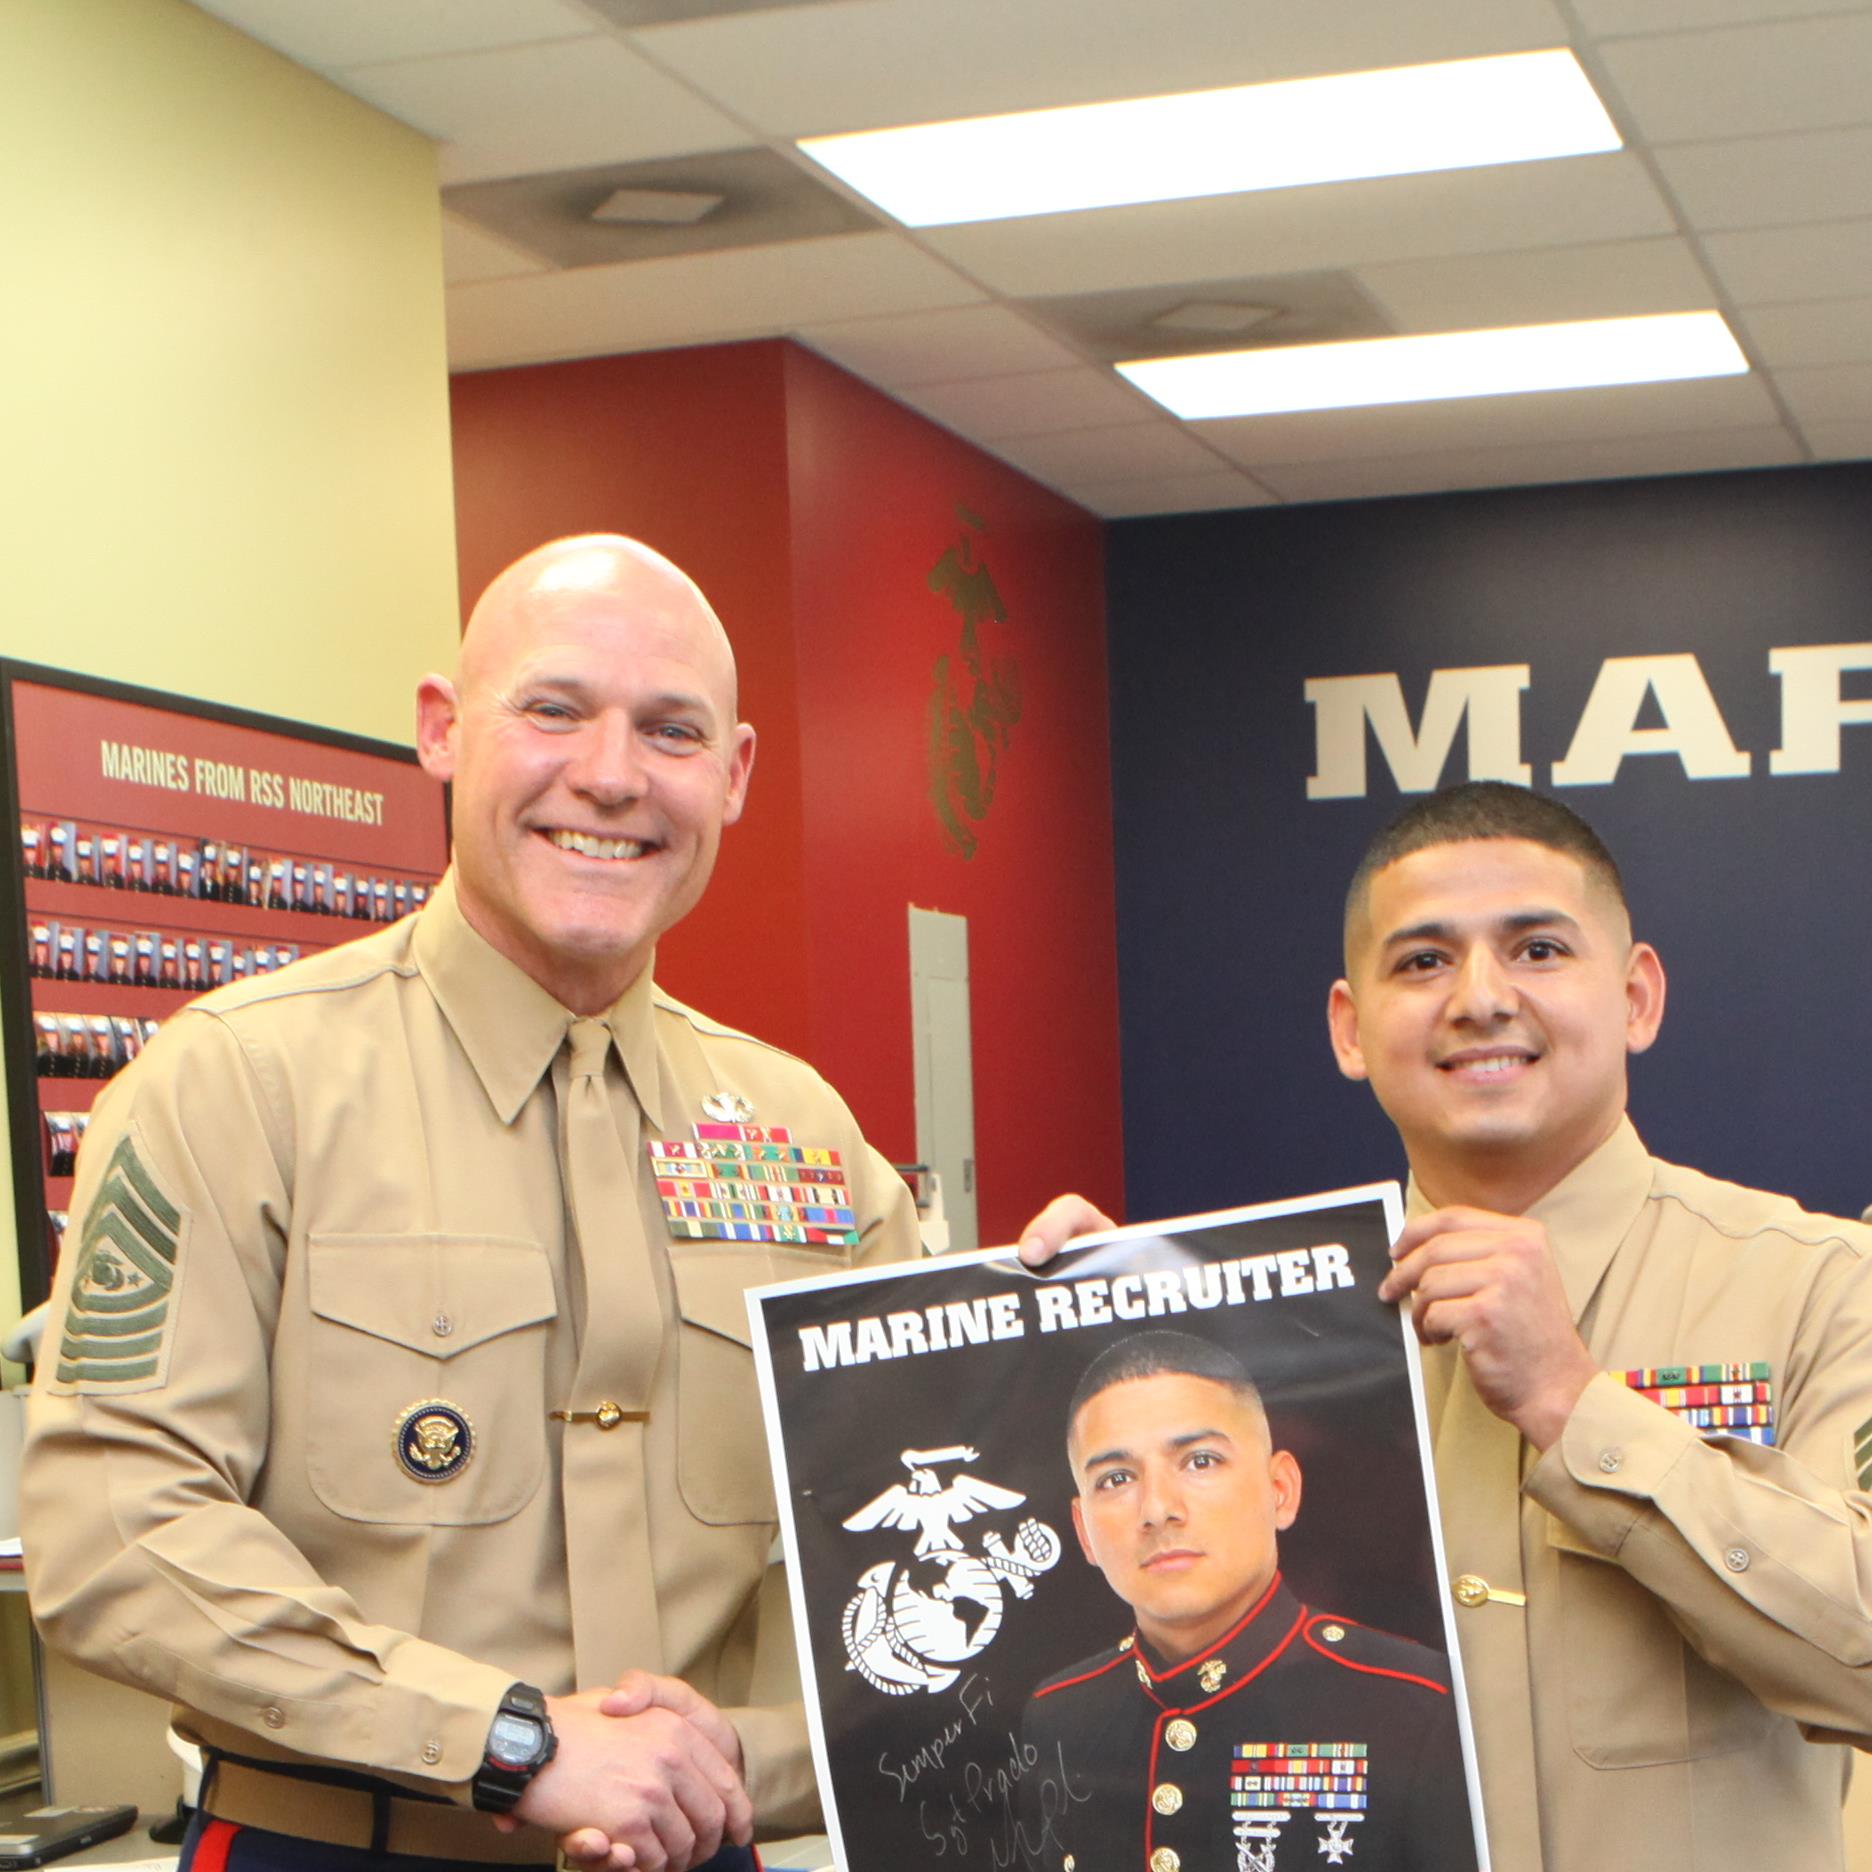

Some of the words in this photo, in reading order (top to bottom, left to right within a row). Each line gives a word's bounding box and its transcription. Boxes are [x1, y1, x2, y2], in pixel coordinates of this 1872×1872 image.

[100, 739, 189, 792] MARINES
[194, 759, 246, 802] FROM
[249, 769, 285, 811] RSS
[289, 776, 385, 827] NORTHEAST
[798, 1287, 1025, 1373] MARINE
[1037, 1243, 1356, 1334] RECRUITER
